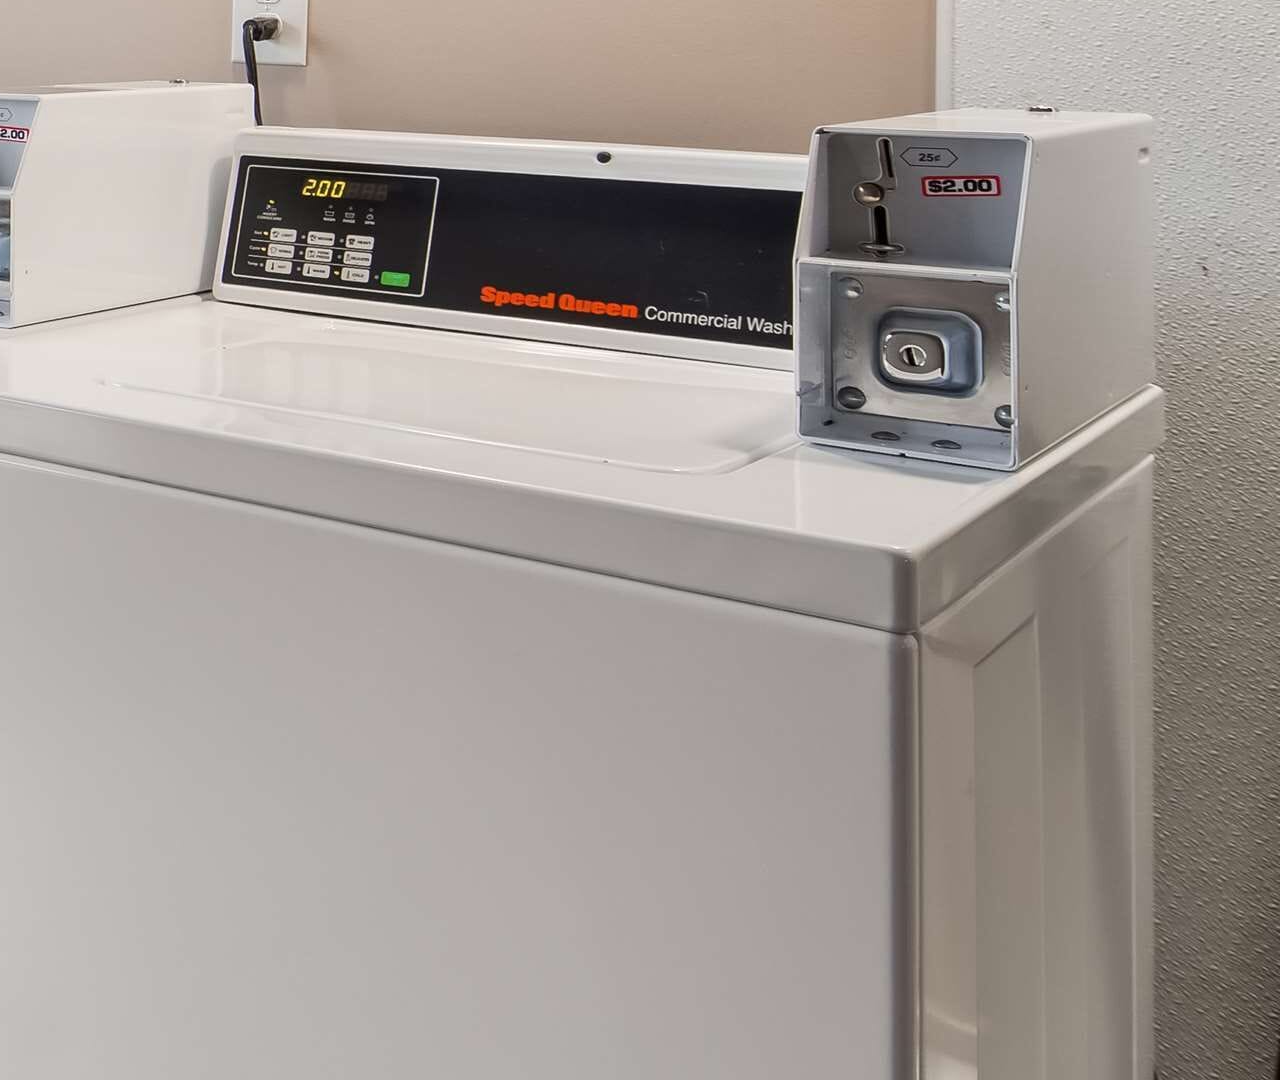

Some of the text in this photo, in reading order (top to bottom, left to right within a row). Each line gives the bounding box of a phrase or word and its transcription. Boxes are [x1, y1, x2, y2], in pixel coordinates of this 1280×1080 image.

[917, 152, 942, 163] 25¢
[301, 178, 346, 198] 2.00
[927, 179, 993, 194] $2.00
[480, 285, 794, 336] Speed Queen Commercial Wash
